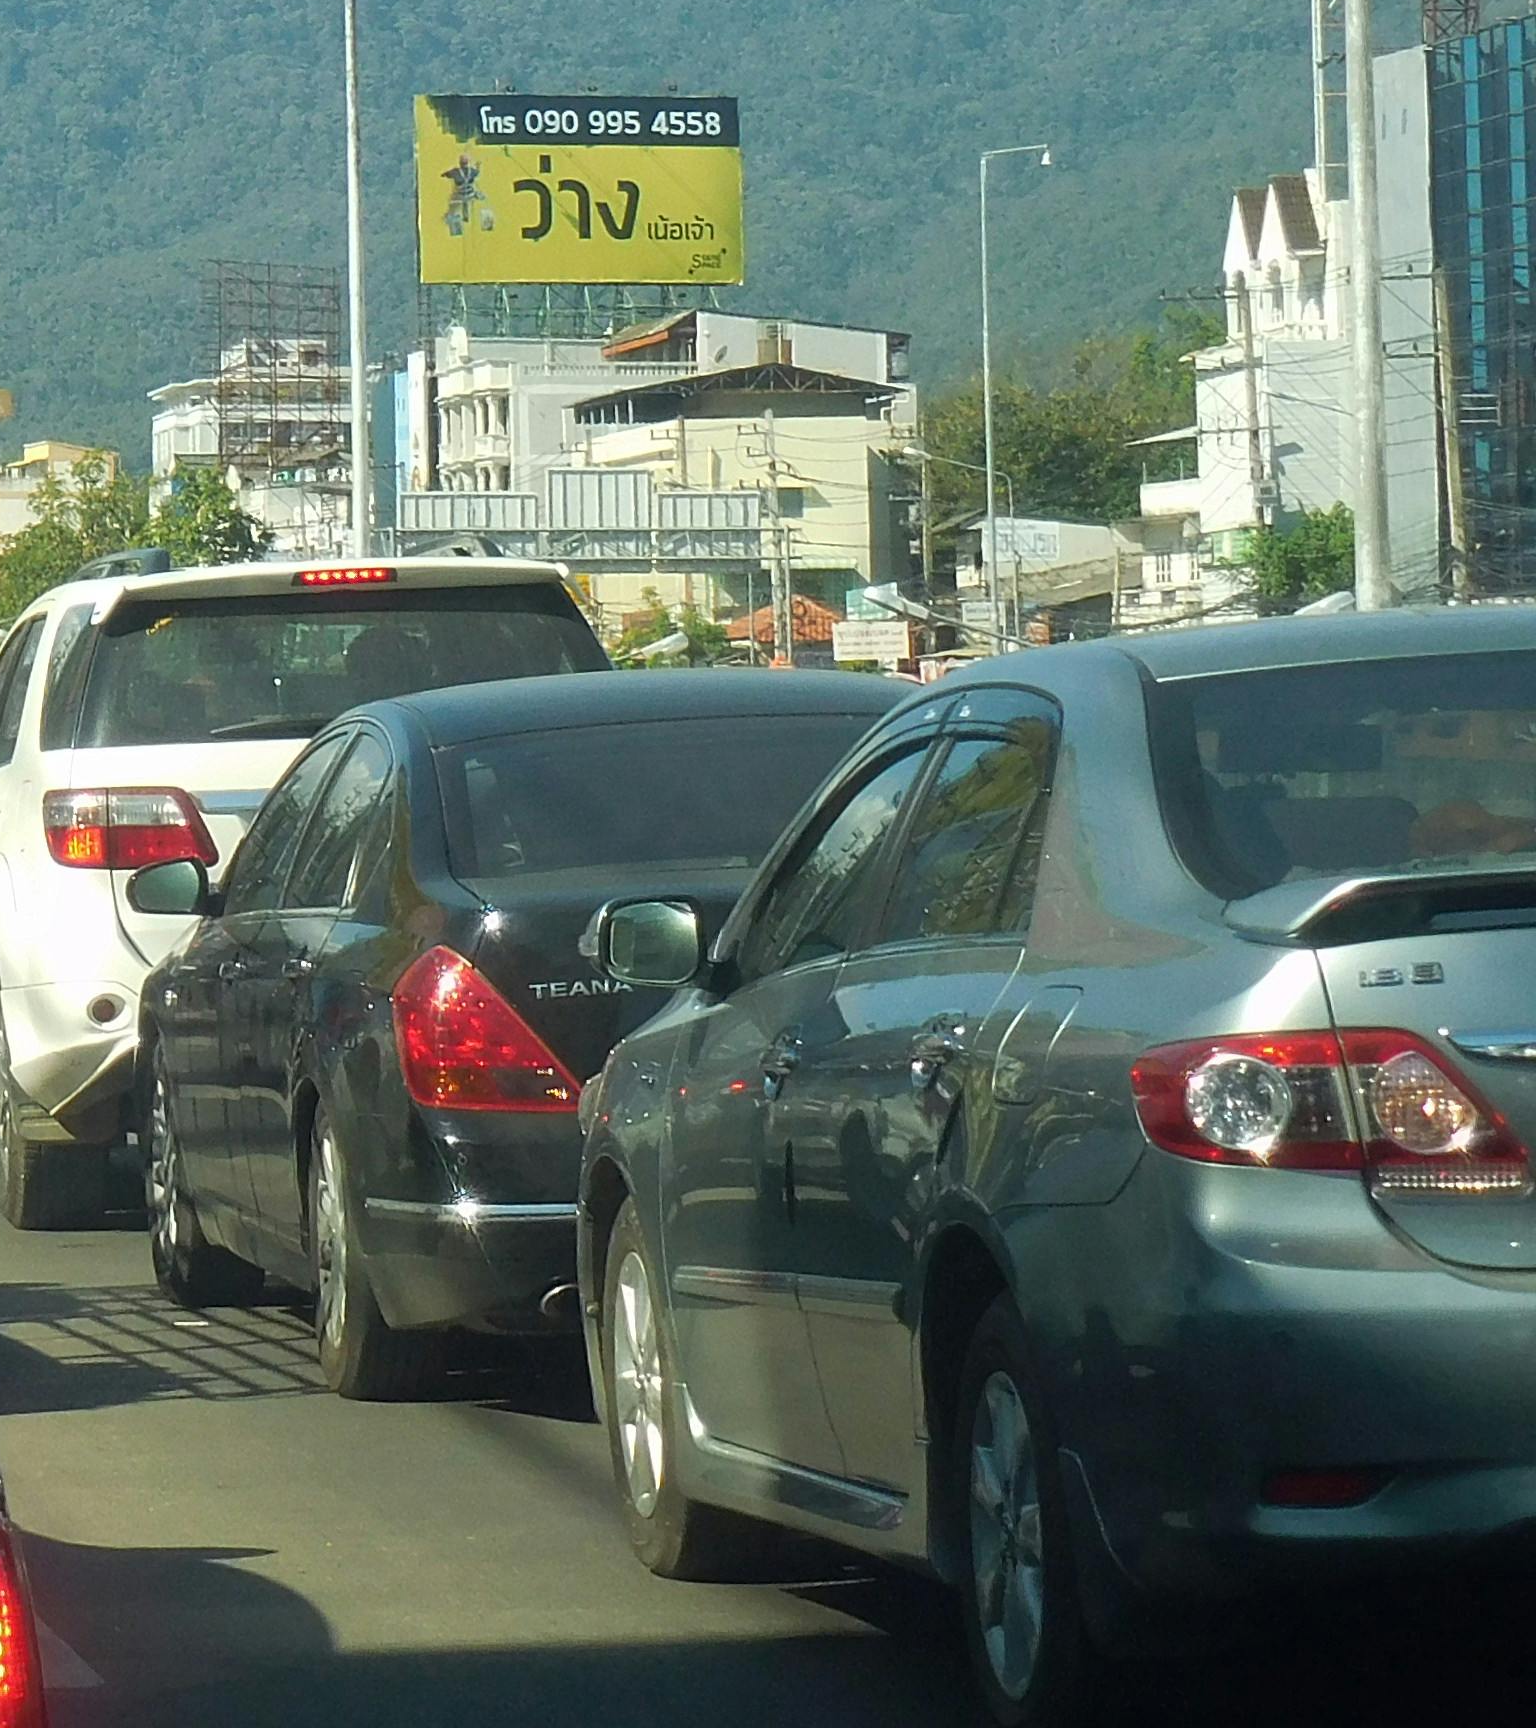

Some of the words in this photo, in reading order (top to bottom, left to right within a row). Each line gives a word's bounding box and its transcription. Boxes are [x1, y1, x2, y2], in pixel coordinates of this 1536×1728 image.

[479, 105, 516, 135] โทร
[524, 109, 579, 135] 090
[588, 110, 642, 136] 995
[650, 111, 722, 136] 4558
[512, 154, 641, 241] ว่าง
[528, 978, 634, 1000] TEANA
